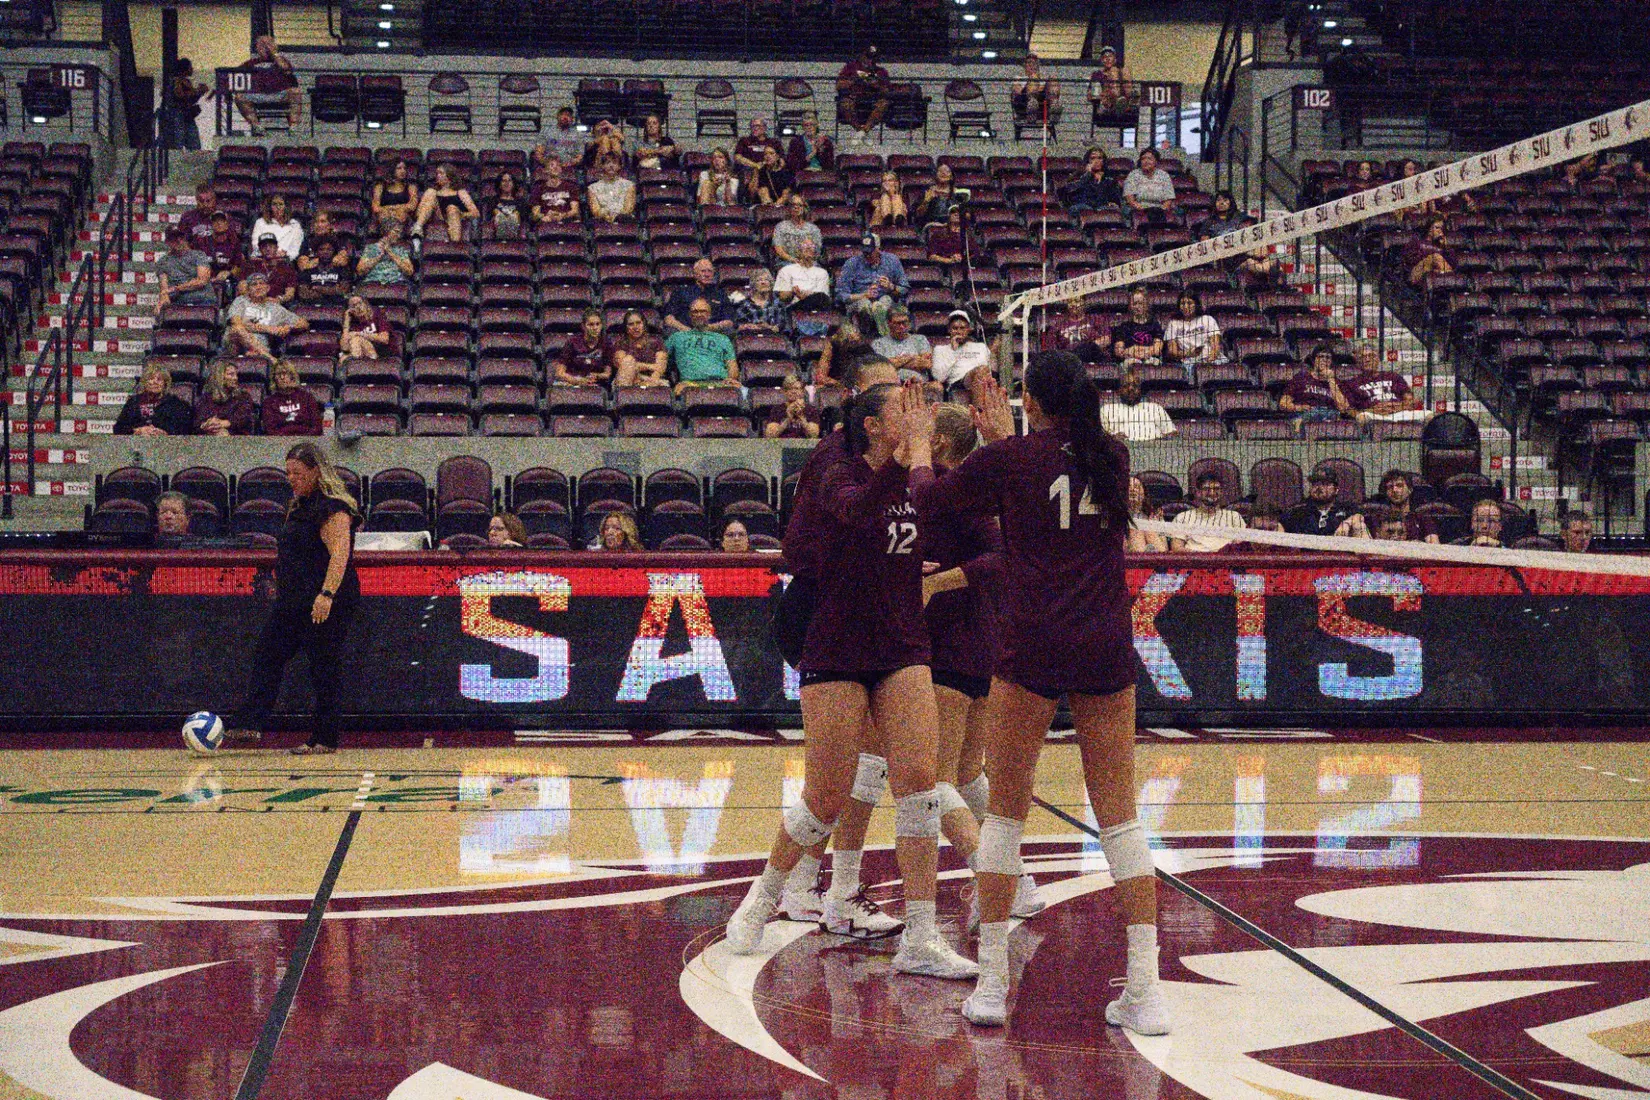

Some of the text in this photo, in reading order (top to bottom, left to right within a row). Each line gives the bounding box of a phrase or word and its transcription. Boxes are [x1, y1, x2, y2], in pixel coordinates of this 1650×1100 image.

[61, 69, 85, 87] 116
[228, 73, 252, 91] 101
[1149, 86, 1172, 104] 101
[1303, 89, 1330, 107] 102
[1588, 118, 1610, 142] SIU
[1532, 137, 1550, 160] SIU
[1480, 154, 1498, 175] SIU
[1433, 170, 1450, 189] SIU
[1391, 183, 1406, 202] SIU
[1351, 195, 1366, 213] SIU
[1316, 206, 1329, 224] SIU
[1252, 226, 1264, 242] SIU
[1283, 217, 1295, 233] SIU
[121, 342, 151, 350] TOYOTA
[111, 367, 142, 375] TOYOTA
[101, 393, 129, 402] TOYOT
[1048, 473, 1110, 530] 14
[886, 521, 918, 554] 12
